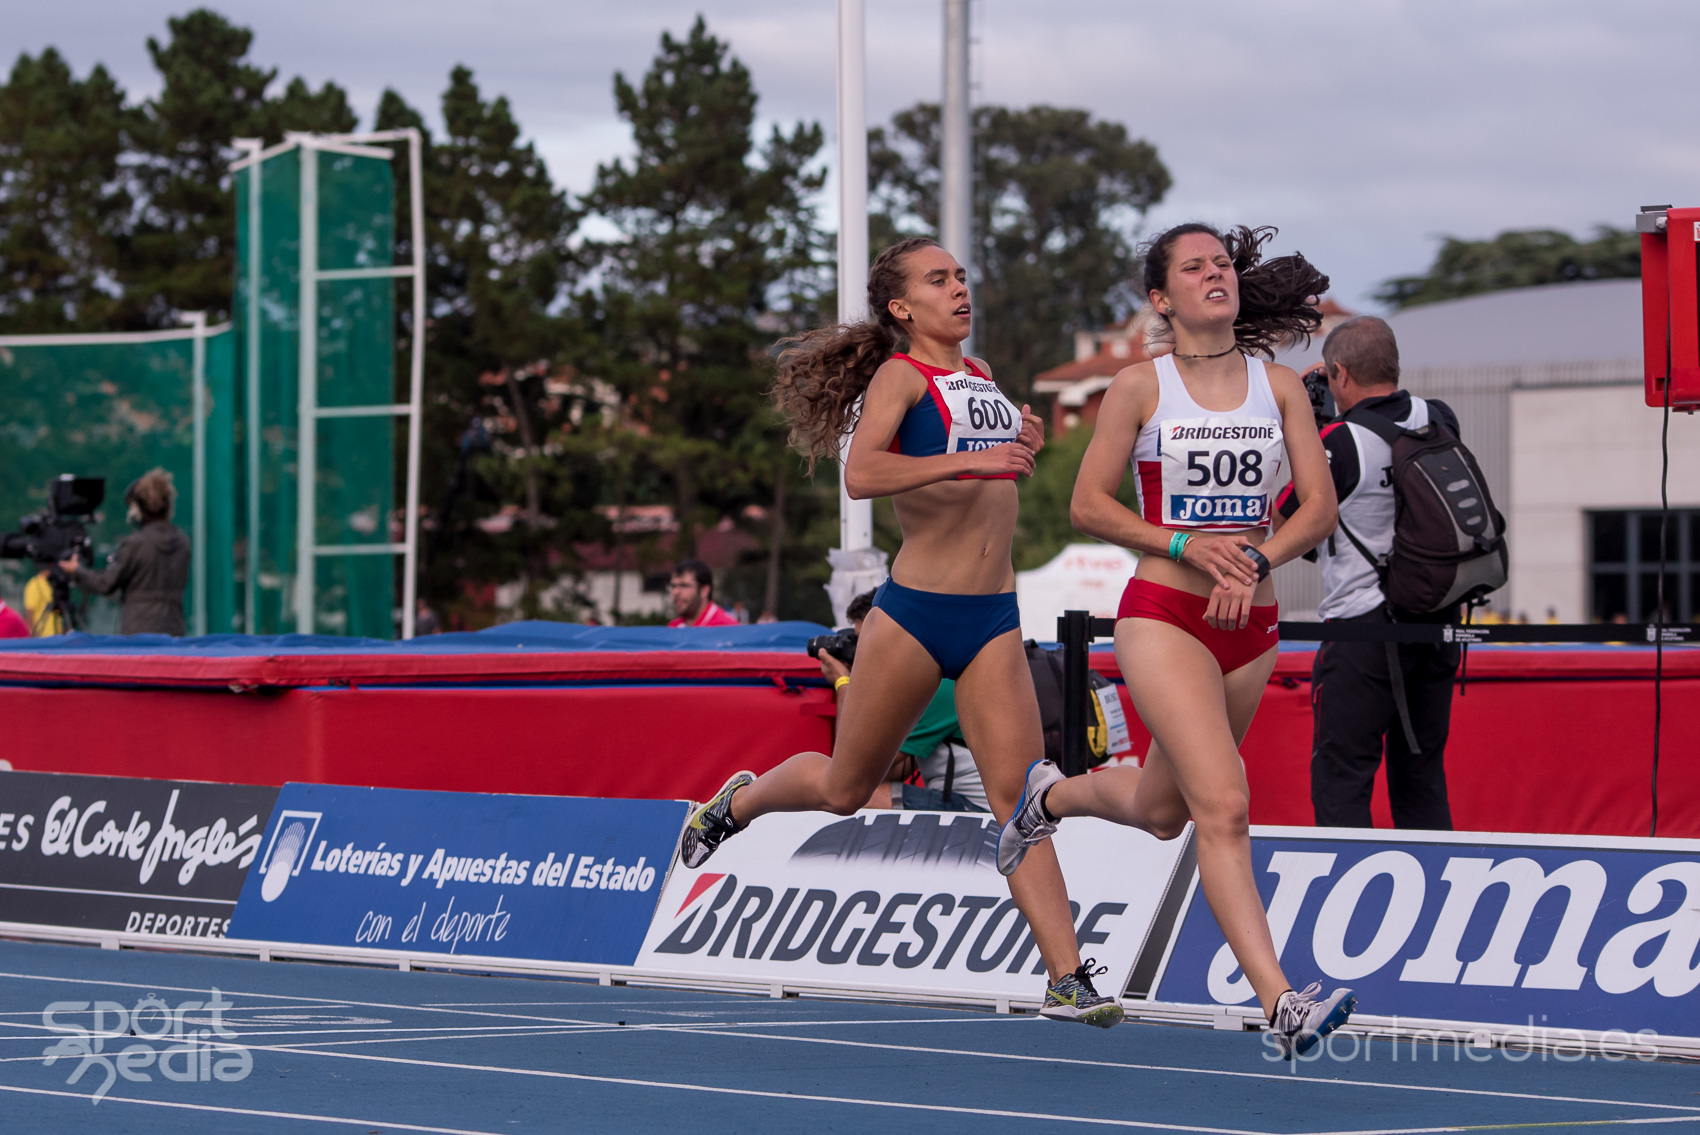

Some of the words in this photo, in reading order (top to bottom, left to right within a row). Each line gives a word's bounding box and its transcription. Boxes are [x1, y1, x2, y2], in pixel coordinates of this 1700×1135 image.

[967, 396, 1013, 431] 600
[966, 440, 1013, 452] Jom
[1169, 425, 1274, 441] BRIDGESTONE
[1187, 449, 1263, 488] 508
[41, 795, 78, 857] El
[73, 799, 151, 862] Corte
[139, 788, 263, 886] Inglés
[310, 840, 404, 877] Loterías
[401, 853, 424, 888] y
[421, 848, 532, 889] Apuestas
[531, 852, 576, 888] del
[570, 855, 656, 893] Estado
[124, 911, 231, 939] DEPORTES
[355, 910, 393, 943] con
[401, 901, 427, 943] el
[430, 894, 512, 955] deporte
